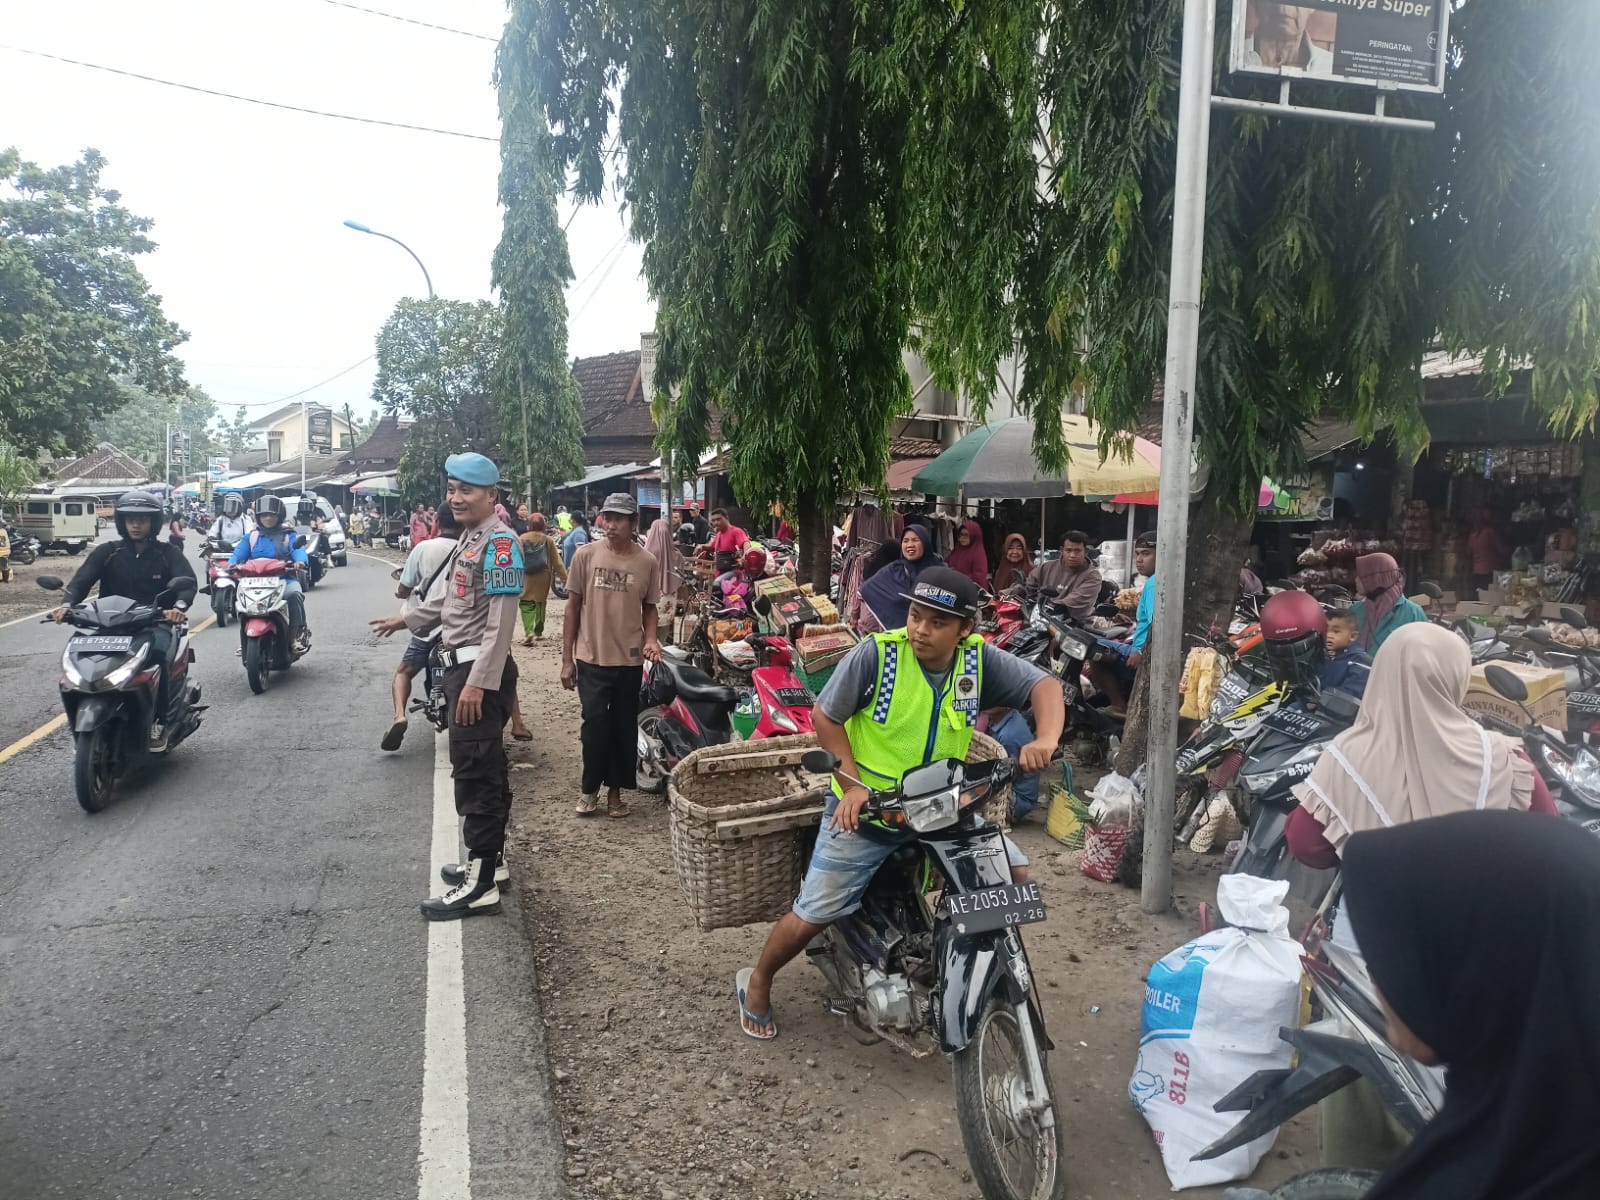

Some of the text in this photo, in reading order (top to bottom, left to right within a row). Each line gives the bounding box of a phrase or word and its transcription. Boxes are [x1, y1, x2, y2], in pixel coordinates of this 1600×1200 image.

[1382, 0, 1431, 17] Super
[952, 698, 978, 711] PARKIR
[950, 883, 1040, 915] AE 2053 JAE
